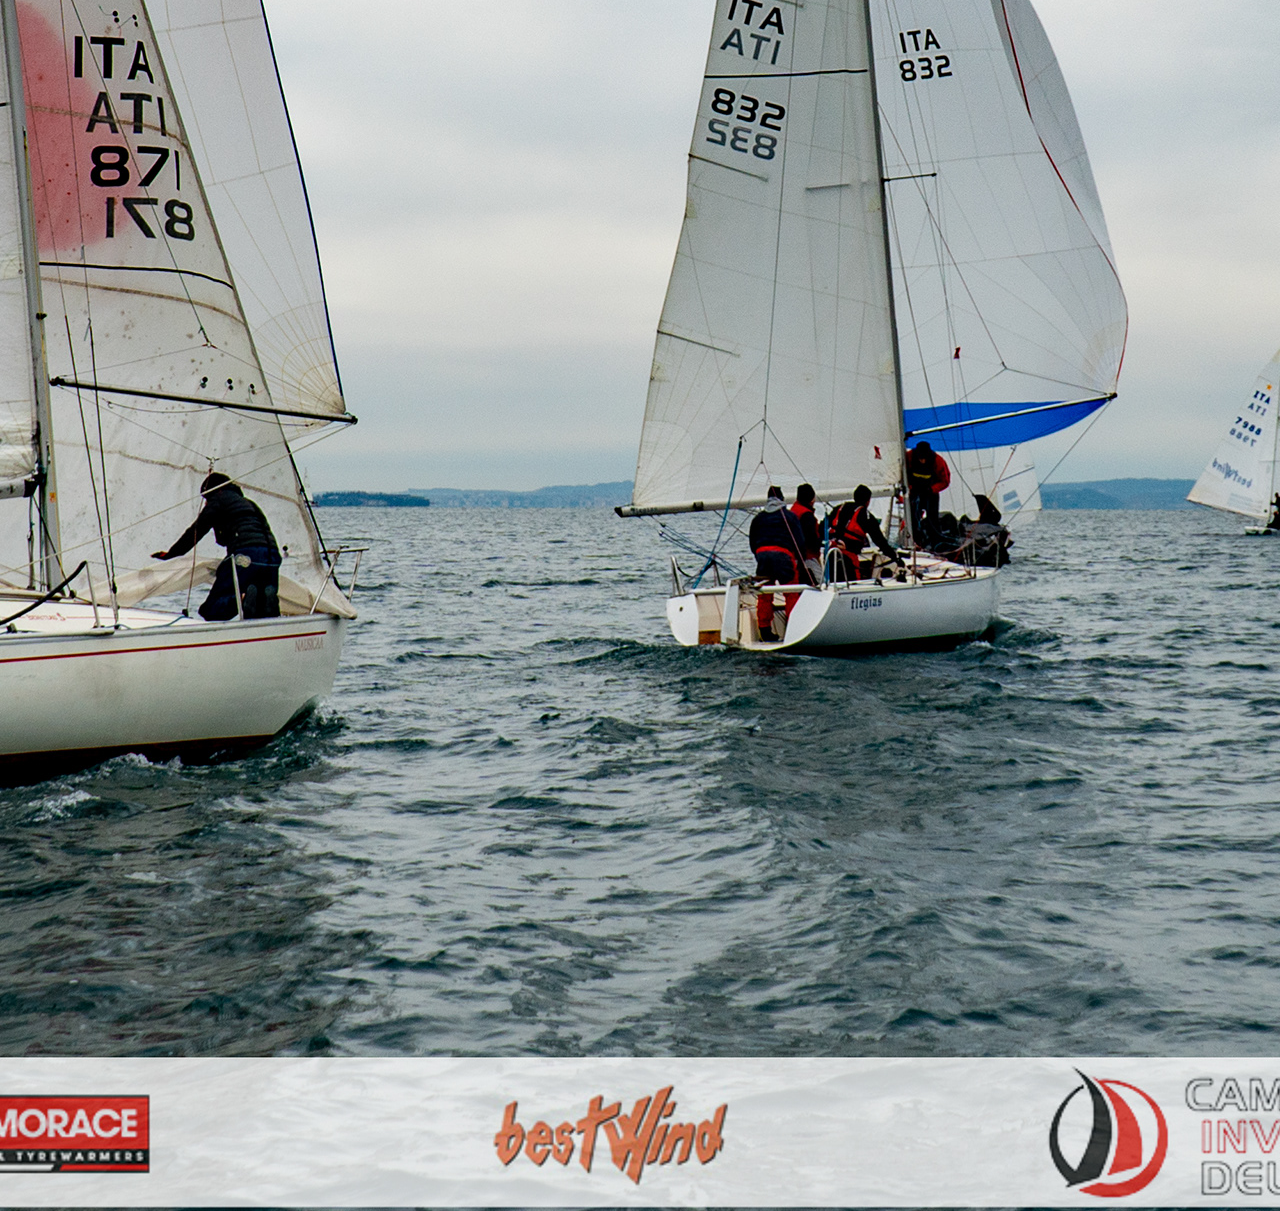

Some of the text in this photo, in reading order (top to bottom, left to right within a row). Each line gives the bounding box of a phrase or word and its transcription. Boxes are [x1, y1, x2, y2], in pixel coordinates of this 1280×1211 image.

[899, 28, 940, 54] ITA
[74, 35, 155, 84] ITA
[899, 55, 952, 82] 832
[711, 87, 786, 131] 832
[90, 146, 180, 190] 871
[1253, 390, 1271, 405] ITA
